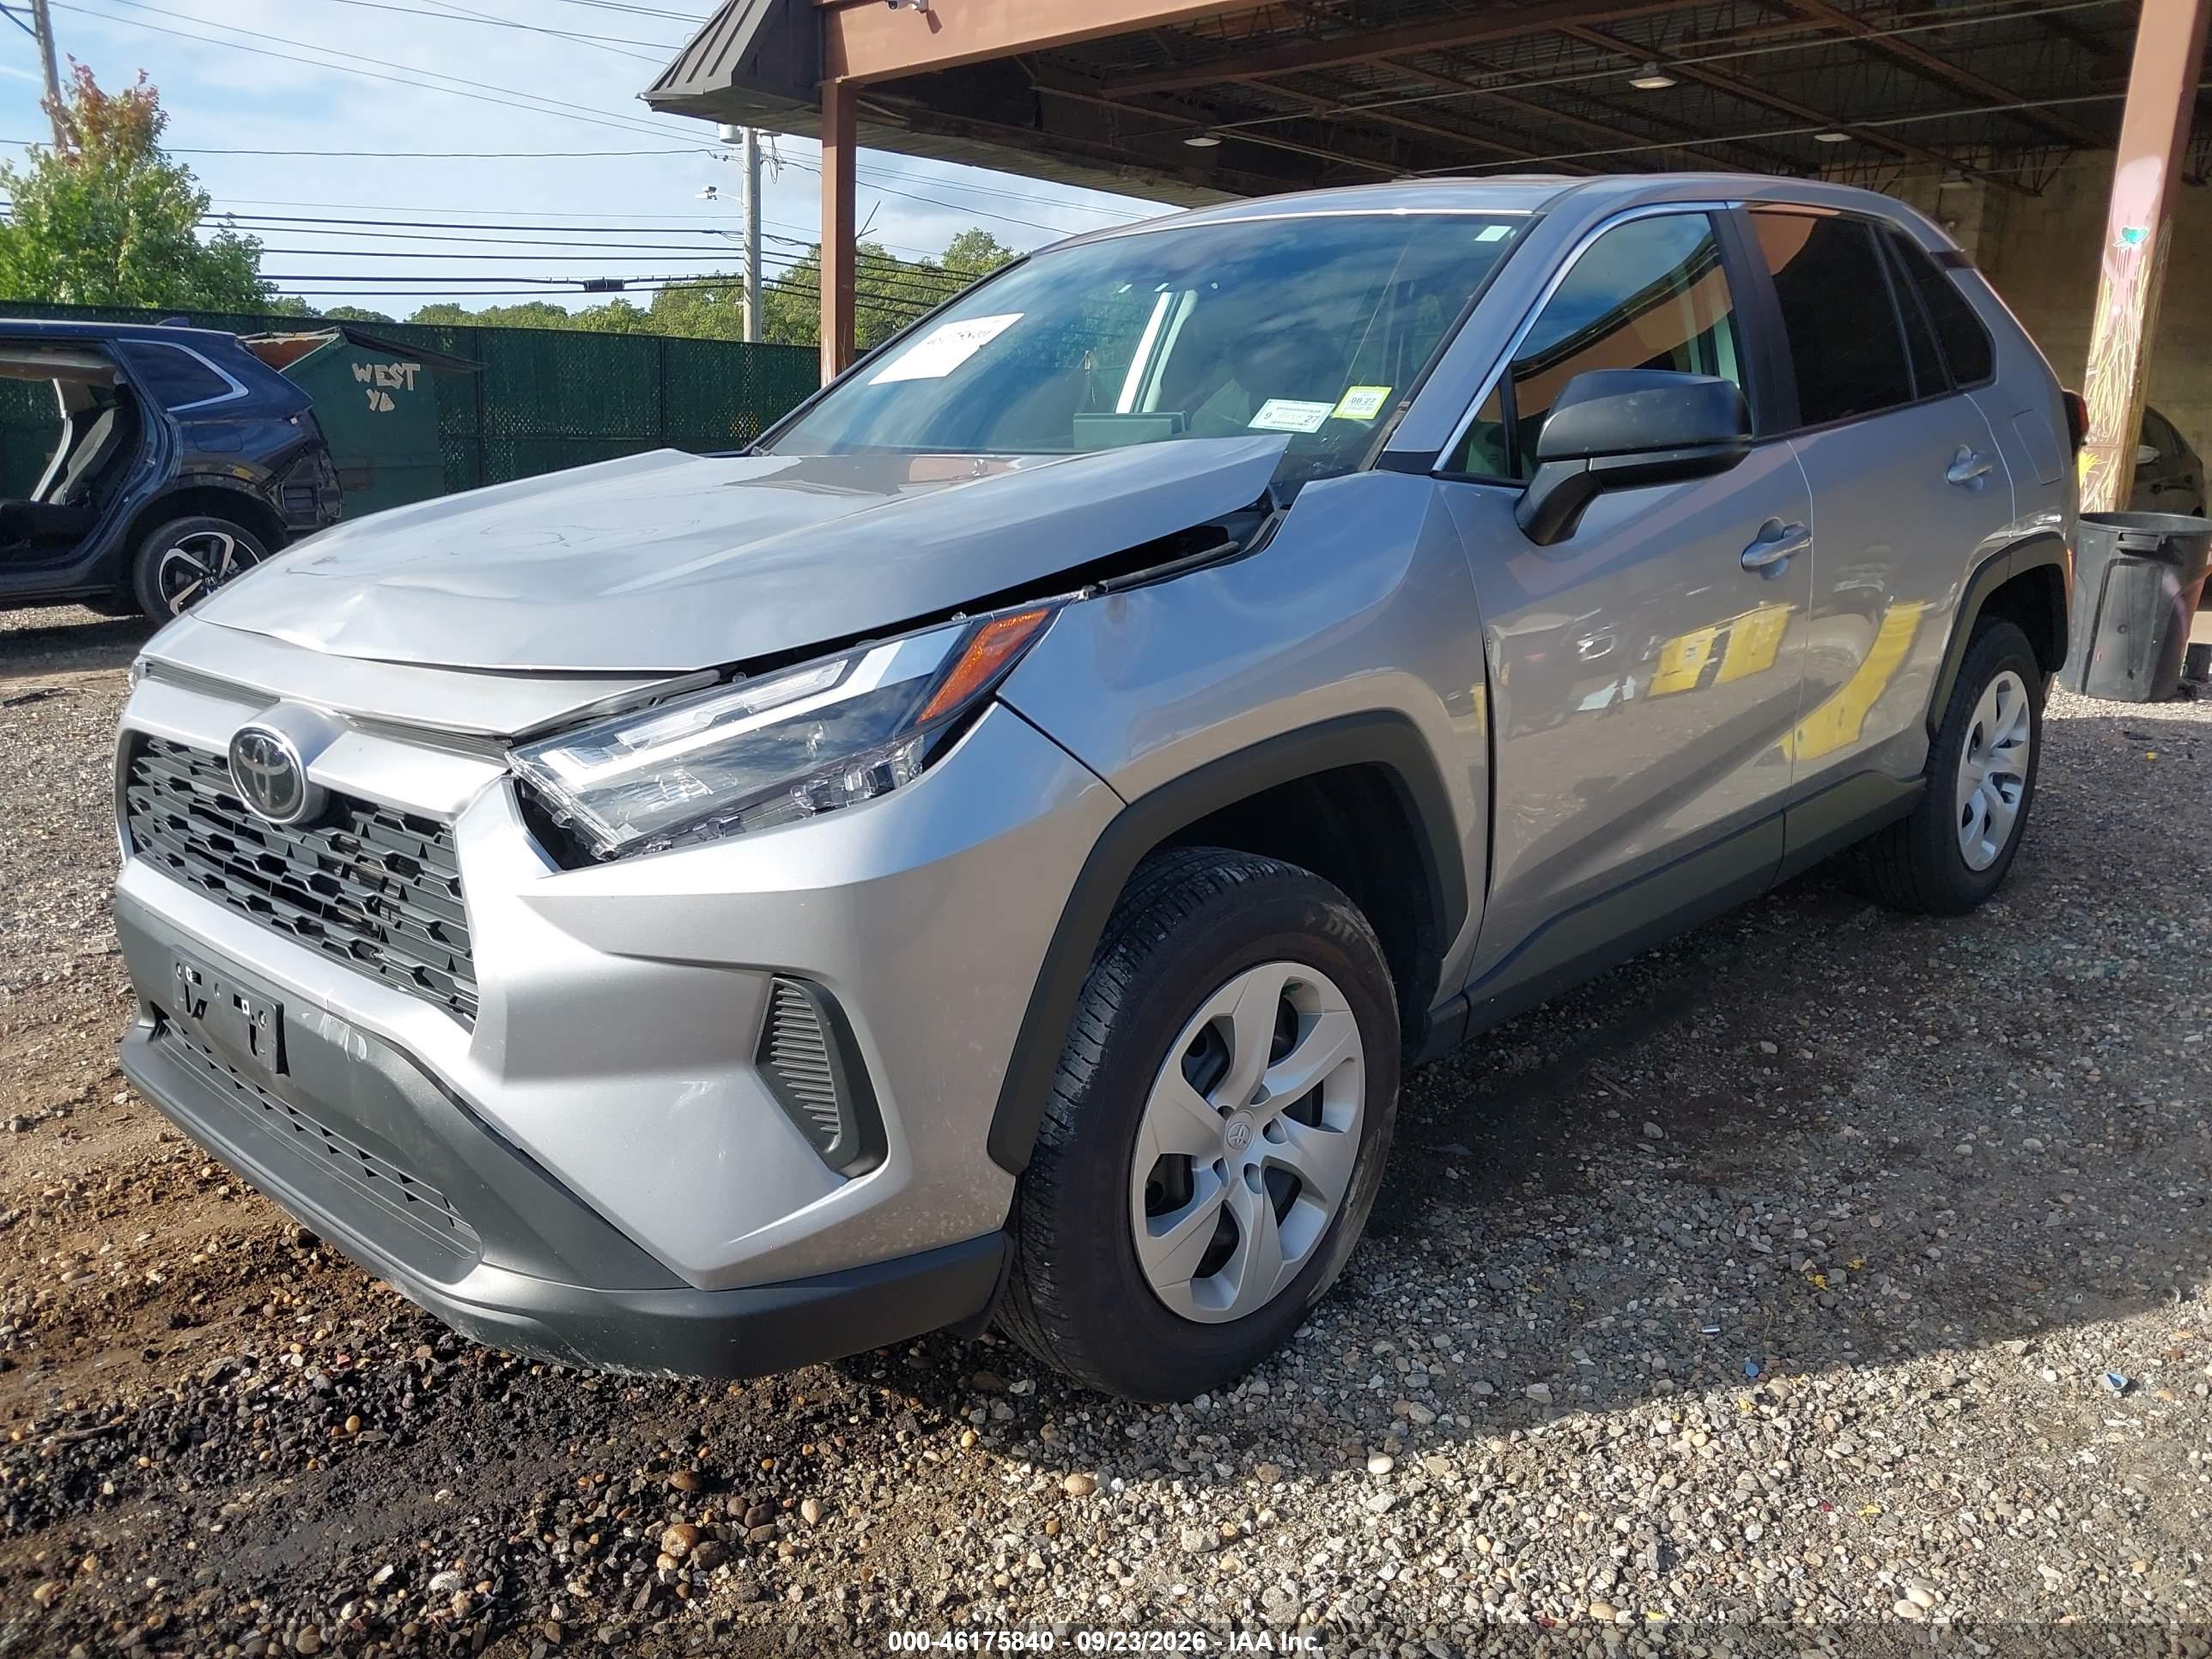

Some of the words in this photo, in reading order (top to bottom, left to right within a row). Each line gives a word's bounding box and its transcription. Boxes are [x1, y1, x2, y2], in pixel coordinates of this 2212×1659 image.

[351, 362, 421, 391] WEST
[1264, 411, 1273, 420] 9
[1304, 415, 1320, 423] 27
